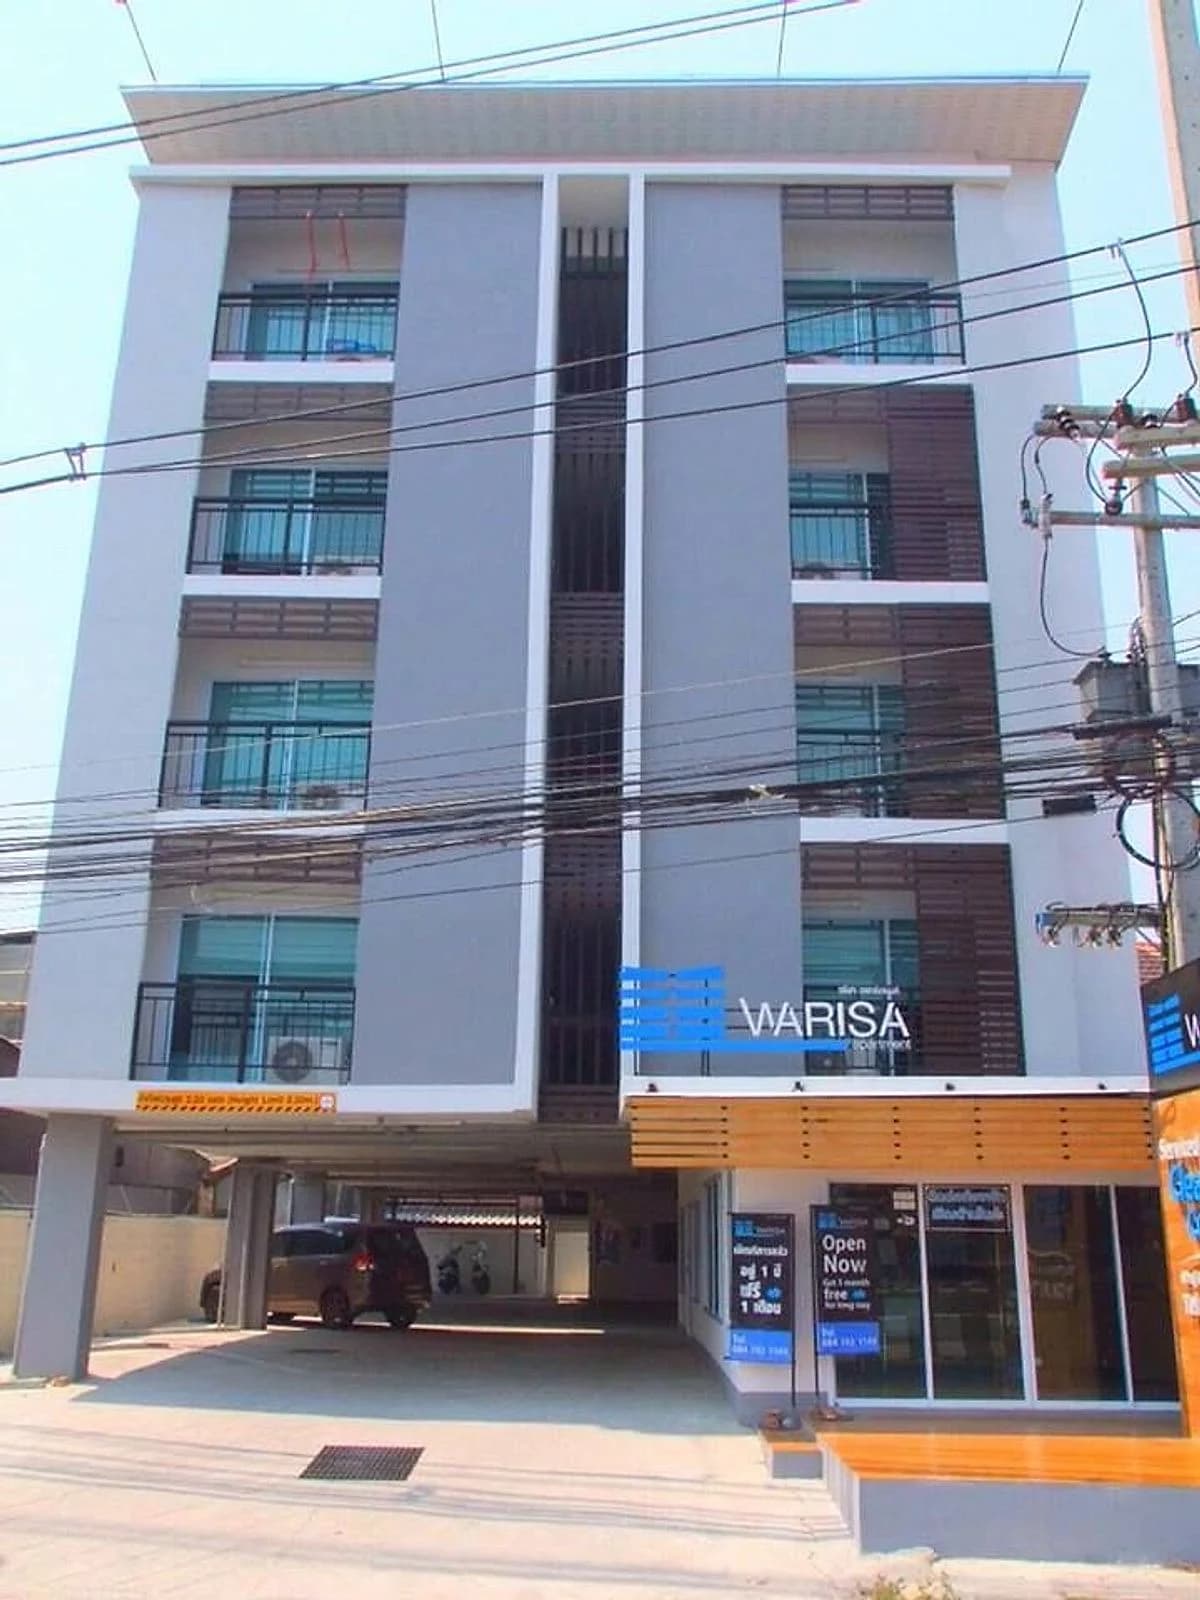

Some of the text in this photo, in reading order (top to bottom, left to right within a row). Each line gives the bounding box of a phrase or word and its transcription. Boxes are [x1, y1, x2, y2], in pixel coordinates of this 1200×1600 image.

[738, 997, 911, 1038] WARISA
[822, 1234, 866, 1255] Open
[823, 1254, 867, 1273] Now
[823, 1287, 848, 1301] free
[741, 1300, 748, 1314] 1
